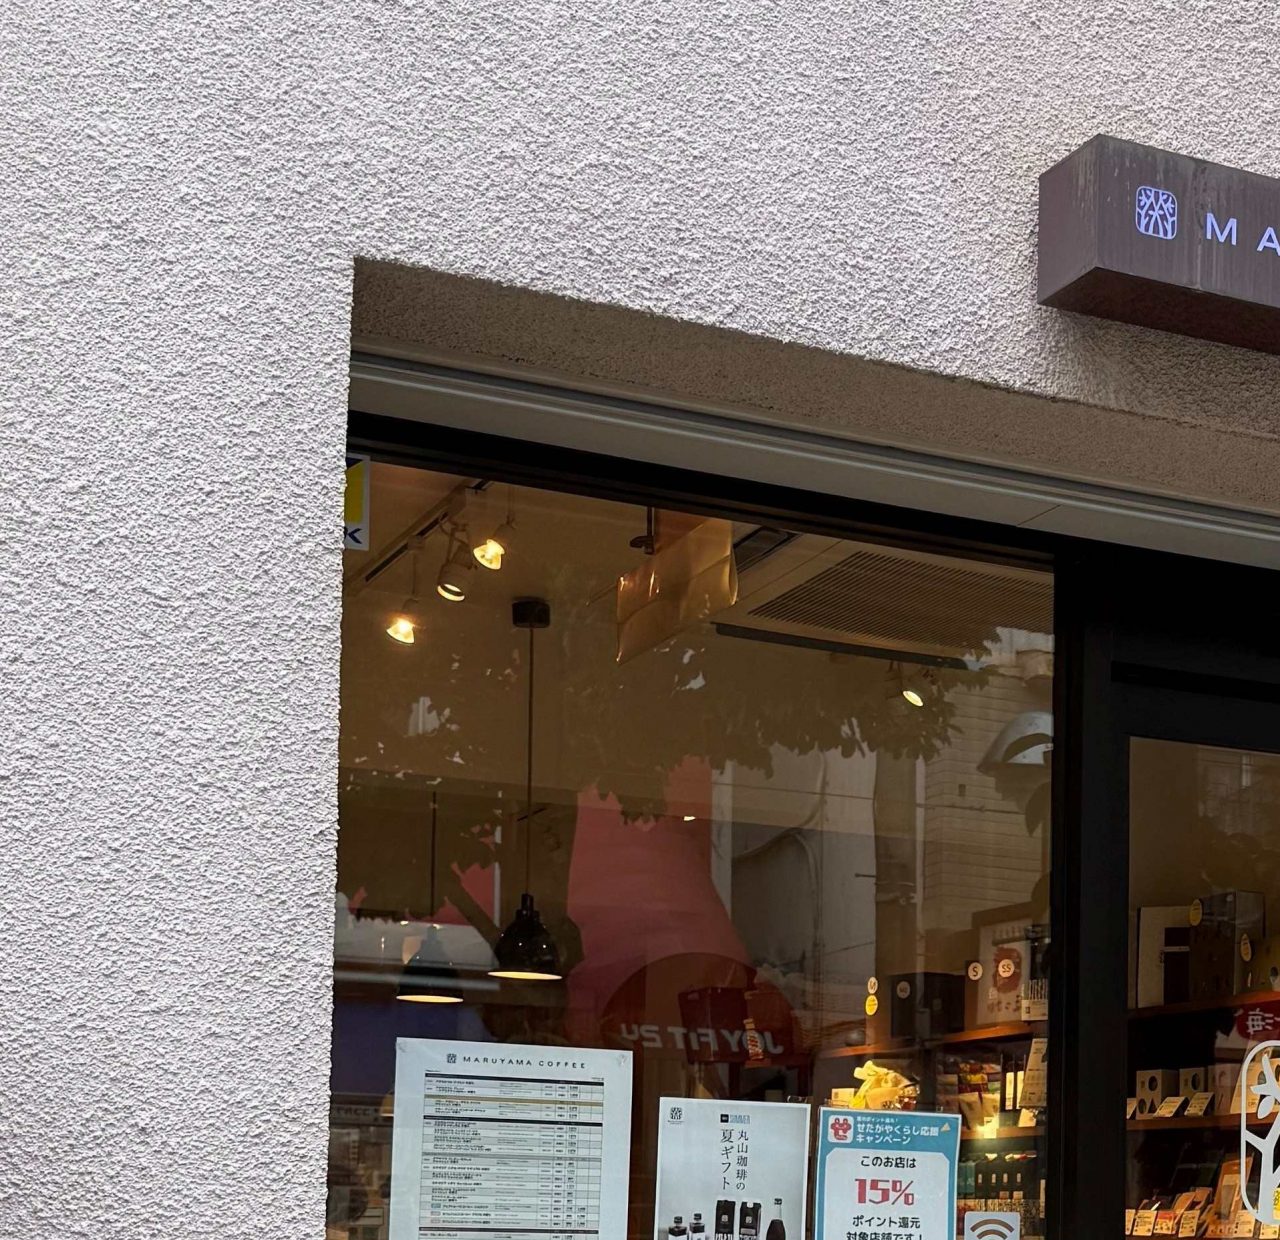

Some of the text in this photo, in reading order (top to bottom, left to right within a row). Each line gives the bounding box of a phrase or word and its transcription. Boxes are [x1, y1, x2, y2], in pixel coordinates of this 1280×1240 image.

[463, 1056, 586, 1069] MARUYAMA COFFEE
[856, 1123, 940, 1137] せたがやくらし応援
[856, 1134, 911, 1144] キャンペーン
[720, 1128, 734, 1190] 夏ギフト
[735, 1129, 749, 1191] 丸山珈琲の
[860, 1156, 917, 1169] このお店は
[854, 1178, 915, 1206] 15%
[852, 1215, 921, 1229] ポイント還元
